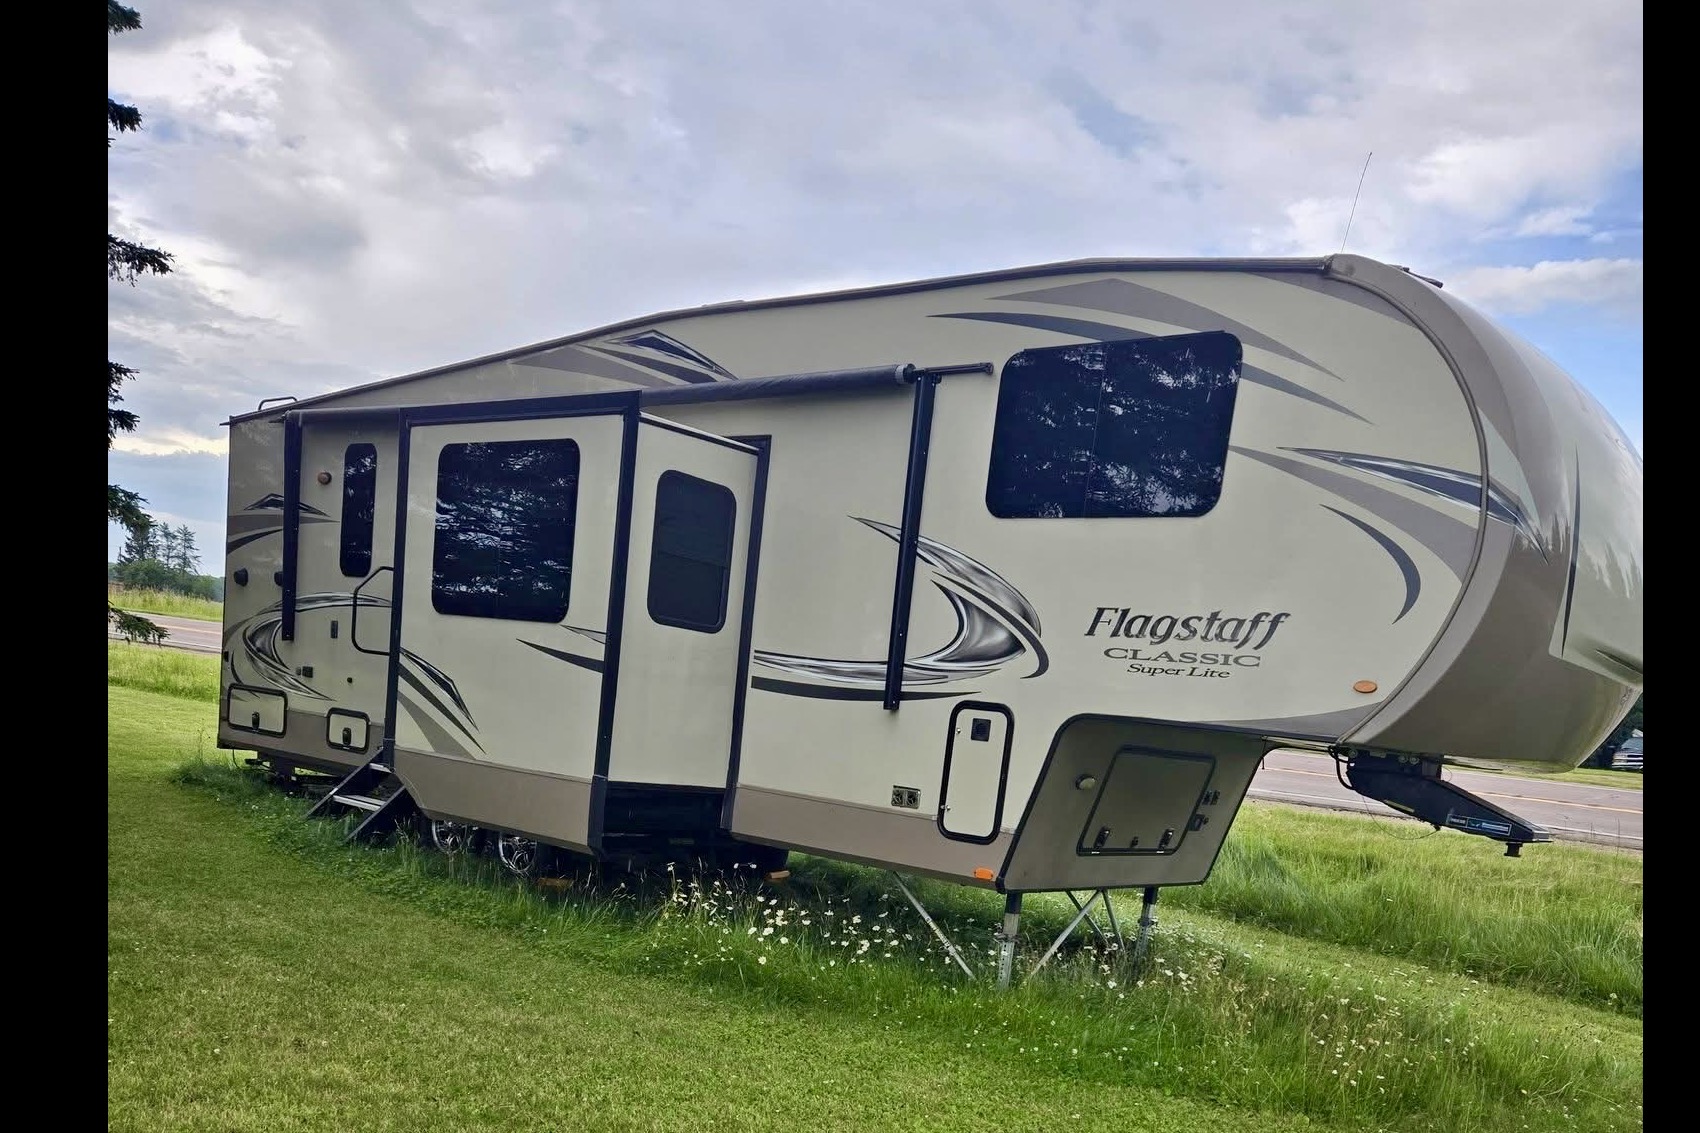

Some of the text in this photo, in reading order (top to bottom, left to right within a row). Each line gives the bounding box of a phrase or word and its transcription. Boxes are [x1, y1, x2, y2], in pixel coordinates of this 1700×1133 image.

[1084, 607, 1291, 650] Flagstaff
[1104, 648, 1261, 667] CLASSIC
[1127, 663, 1231, 679] Super Lite
